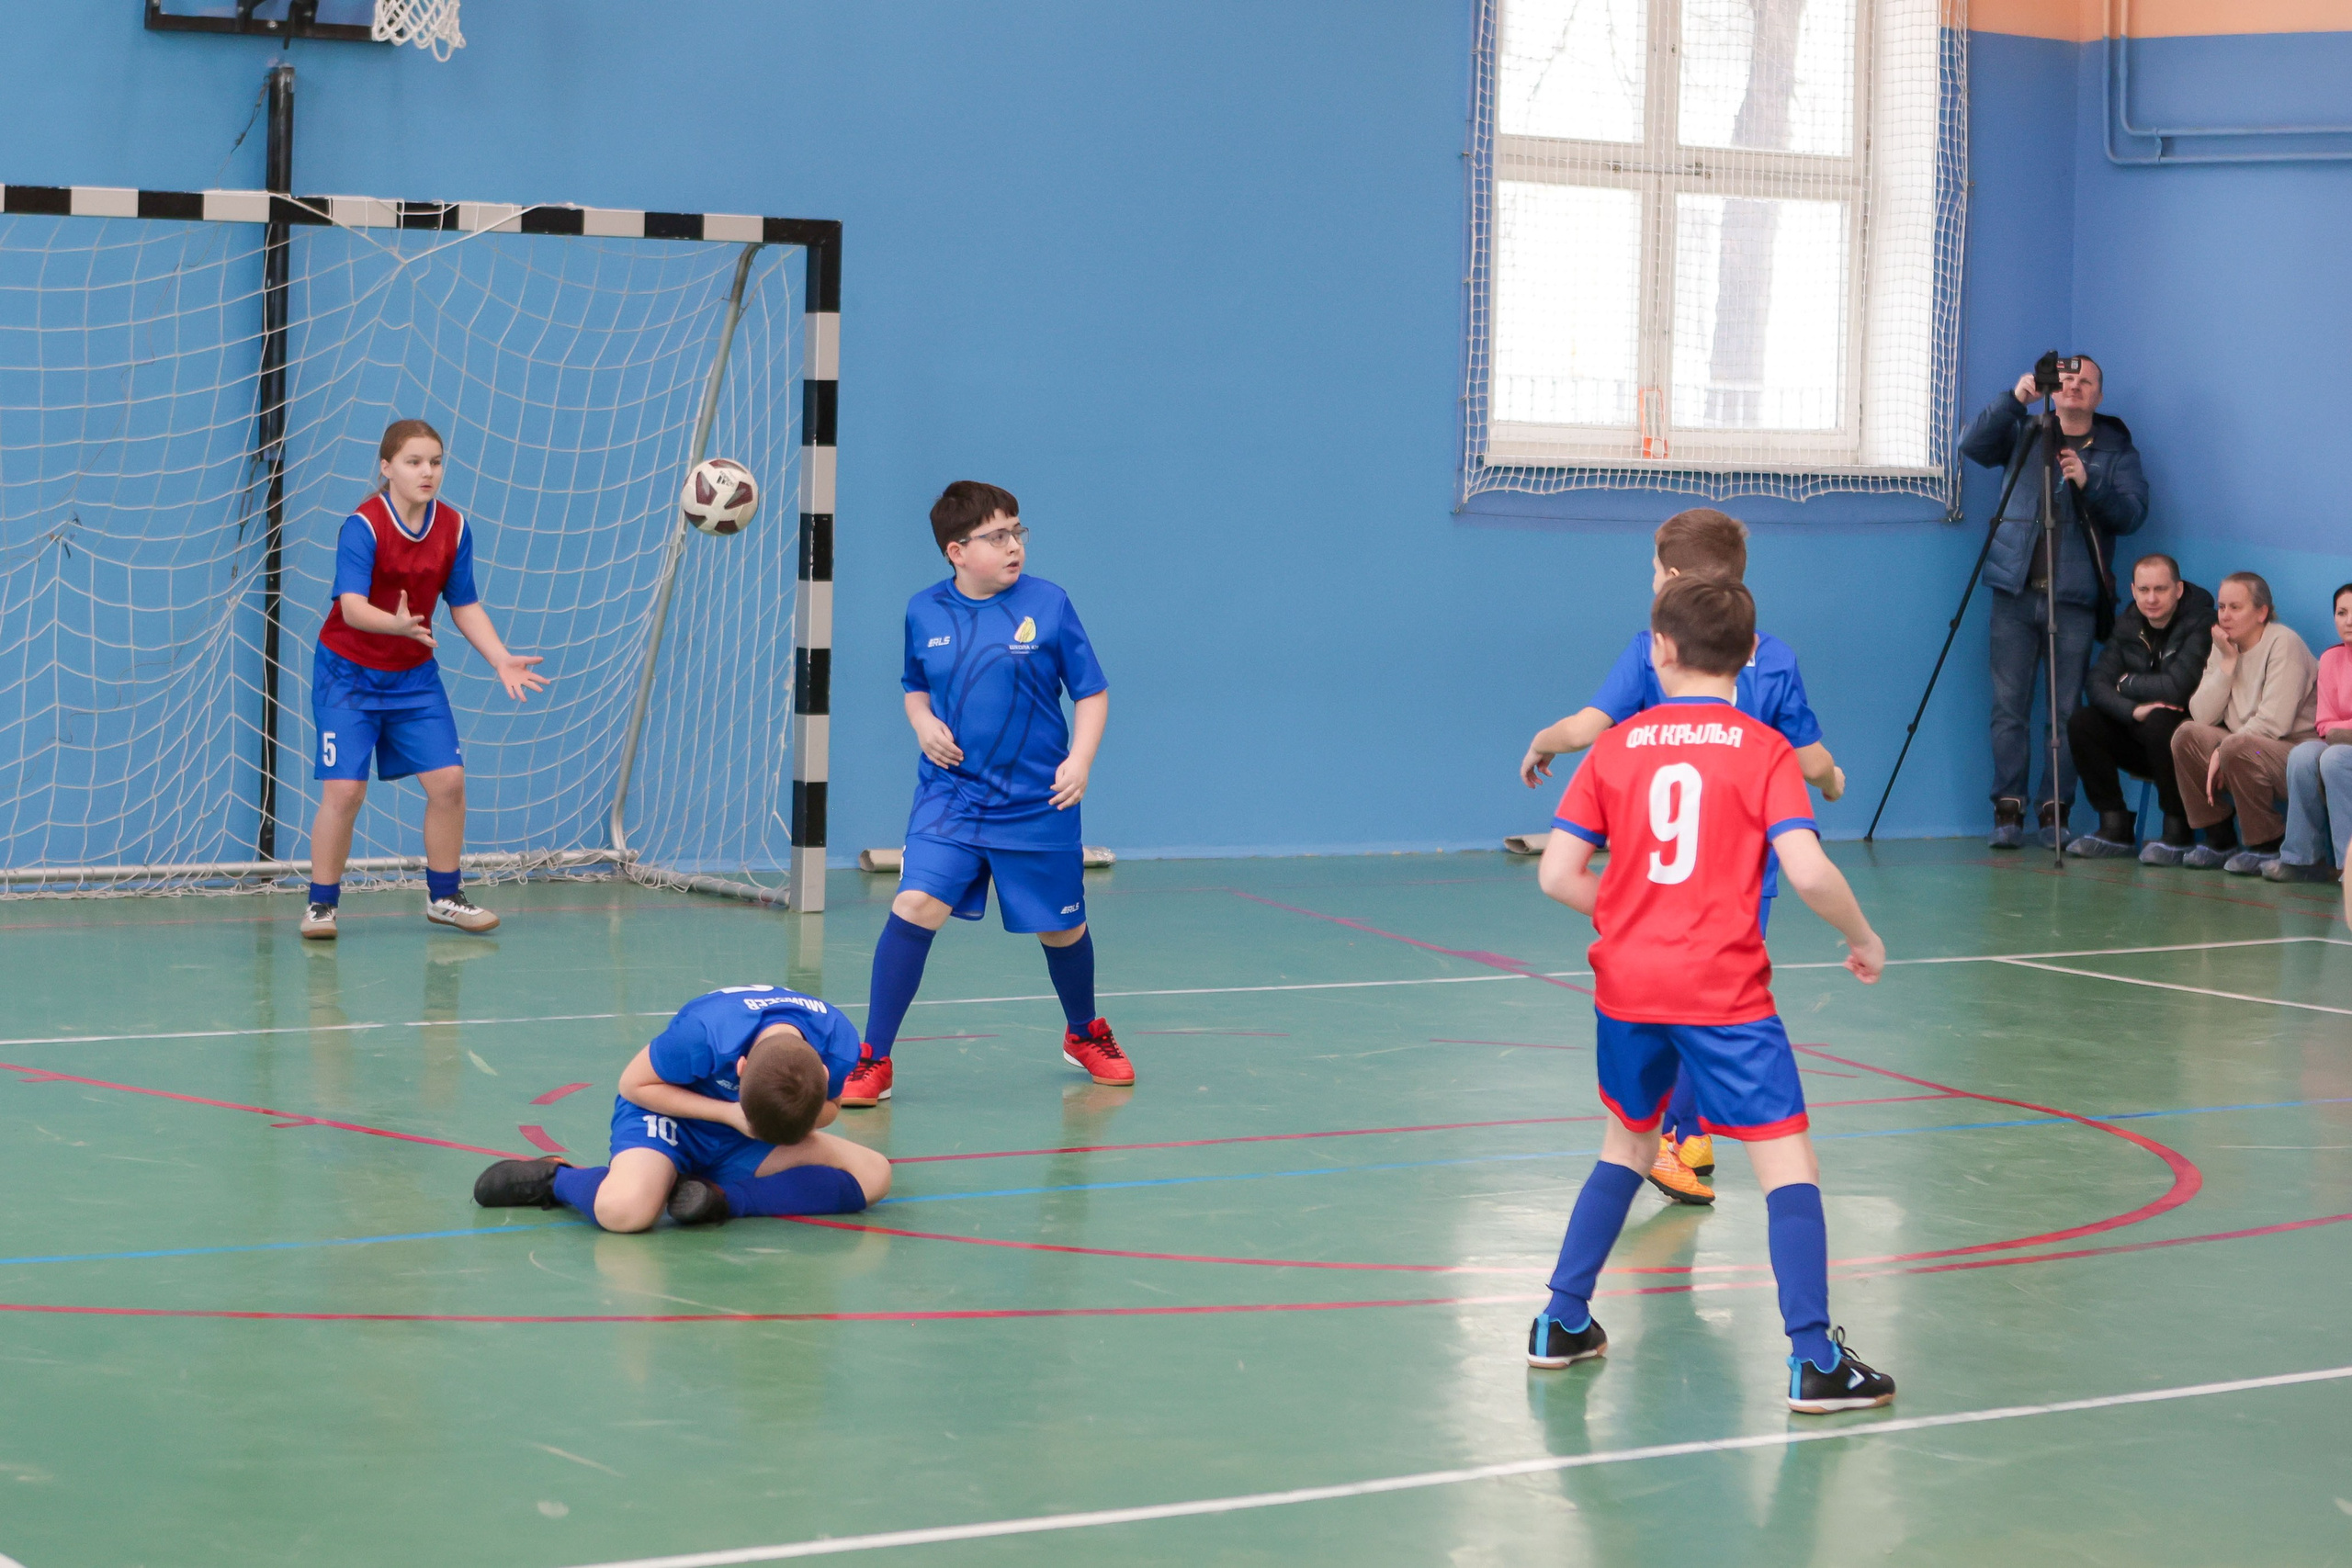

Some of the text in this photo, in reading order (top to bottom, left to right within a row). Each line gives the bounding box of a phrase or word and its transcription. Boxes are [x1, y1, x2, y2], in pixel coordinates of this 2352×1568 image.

[323, 732, 336, 767] 5
[1625, 723, 1743, 748] ФК КРЫЛЬЯ
[1647, 761, 1702, 885] 9
[642, 1114, 679, 1146] 10
